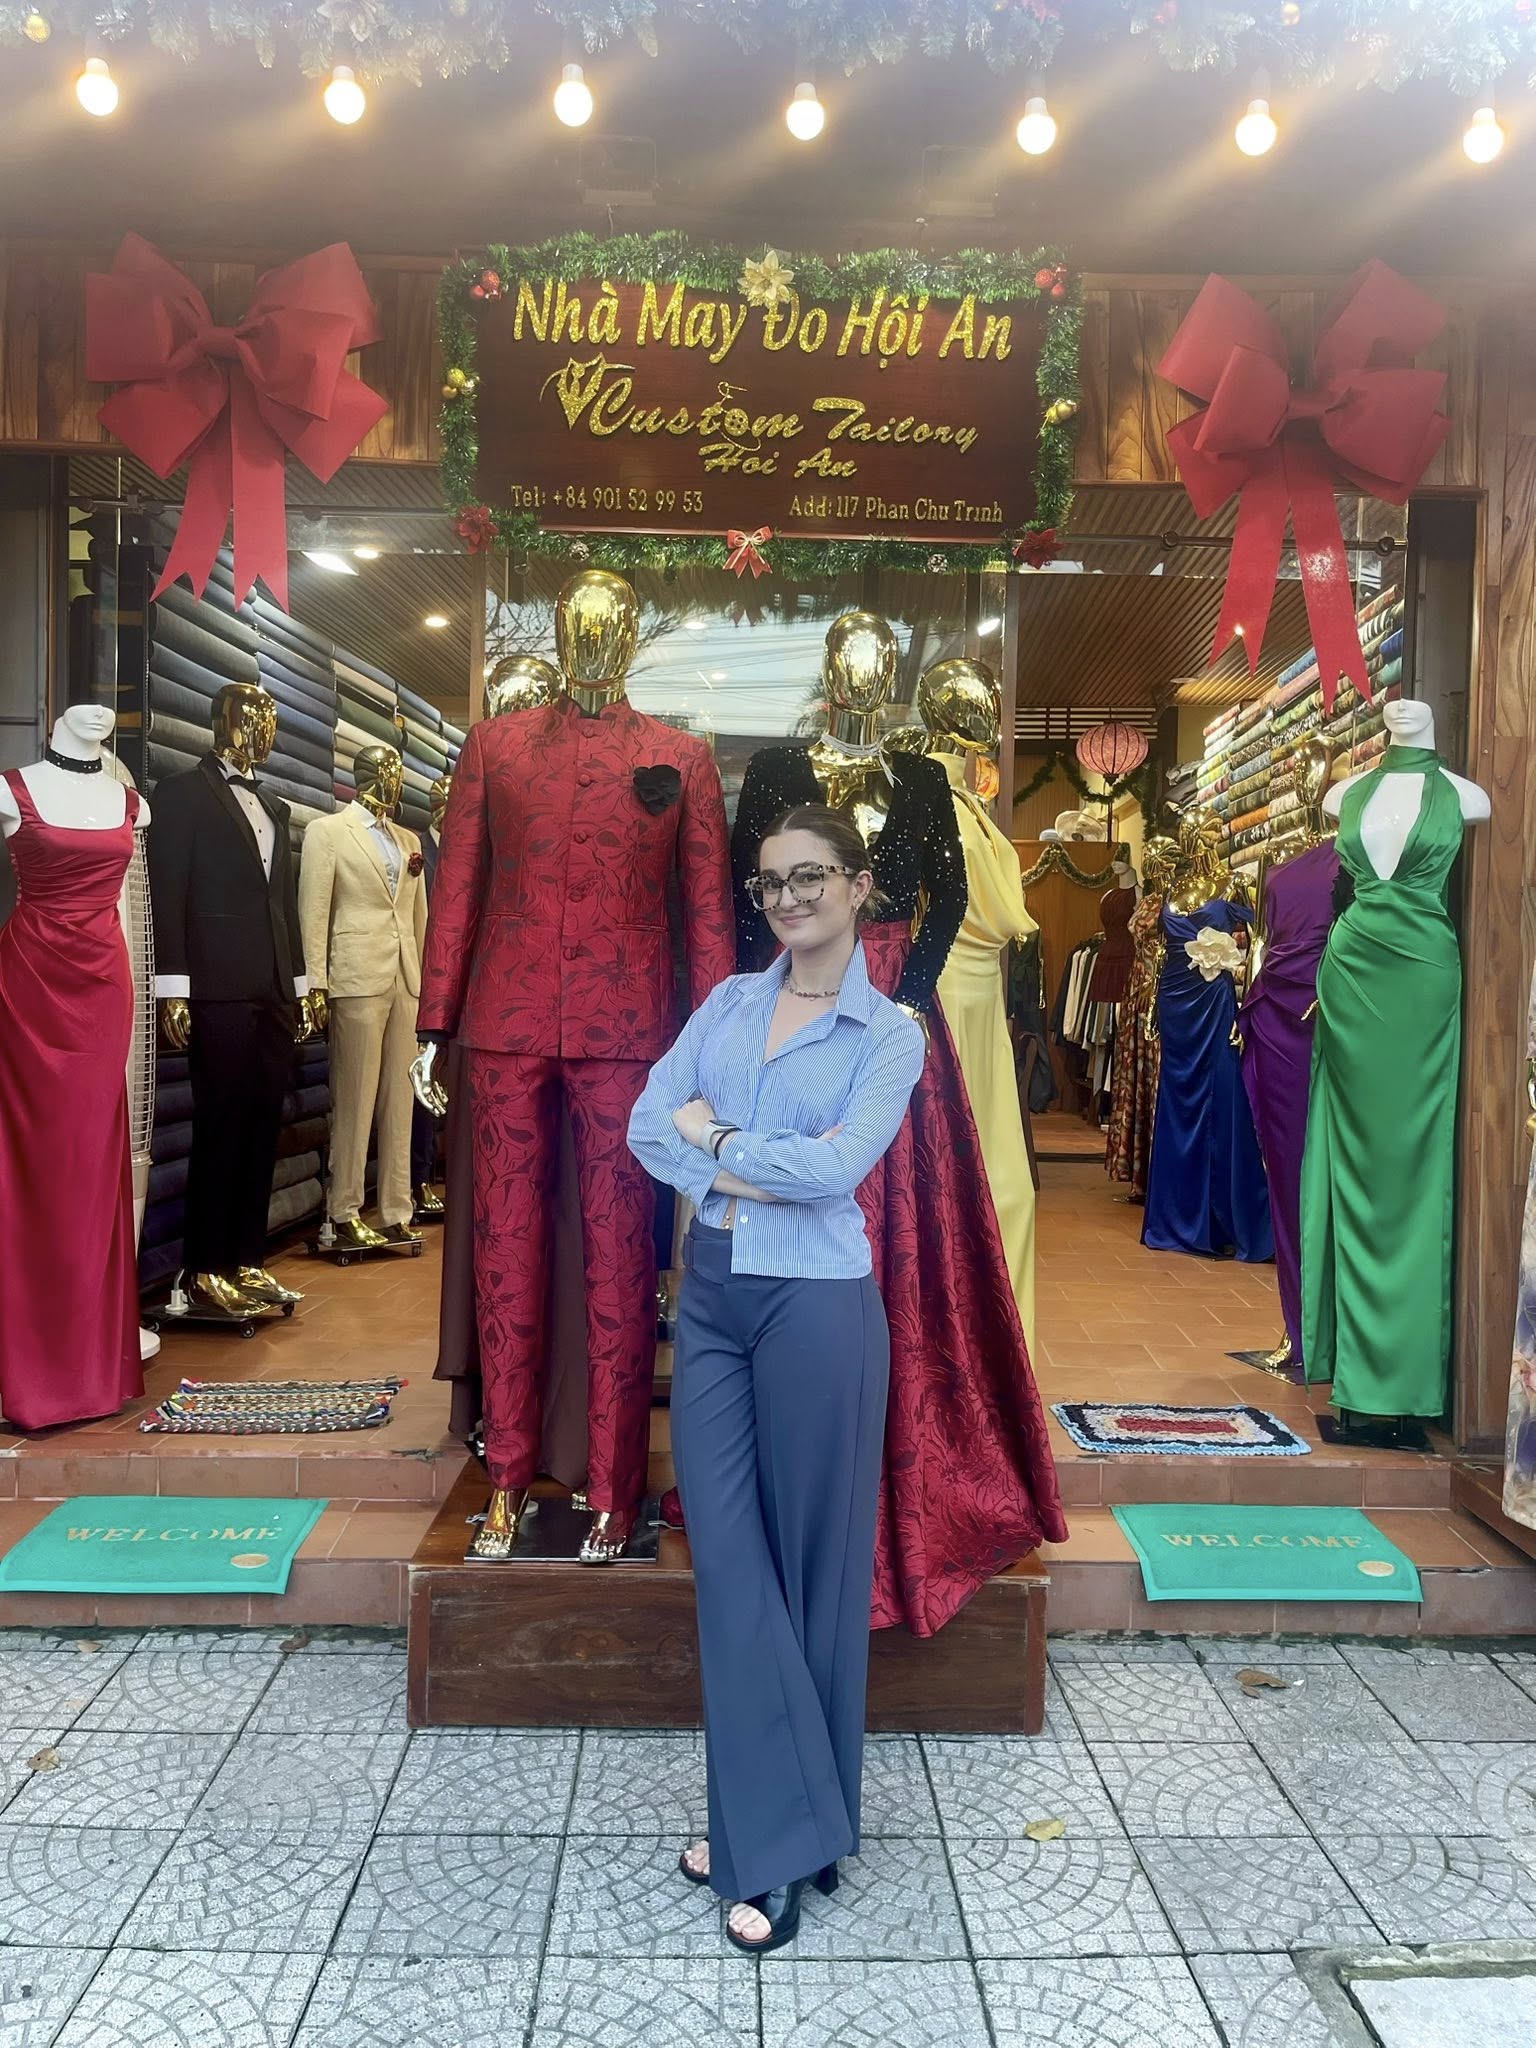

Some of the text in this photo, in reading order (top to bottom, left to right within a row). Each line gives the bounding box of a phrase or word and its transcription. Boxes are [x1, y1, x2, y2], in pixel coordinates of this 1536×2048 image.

[513, 279, 1013, 369] Nhà May Đo Hội An
[588, 377, 805, 437] Custom
[698, 442, 858, 478] Hoi An
[511, 485, 704, 513] Tel: +84 901 52 99 53
[789, 495, 832, 518] Add:
[836, 495, 860, 518] 117
[865, 496, 910, 520] Phan
[914, 498, 950, 521] Chu
[66, 1526, 284, 1543] WELCOME
[1159, 1533, 1373, 1549] WELCOME
